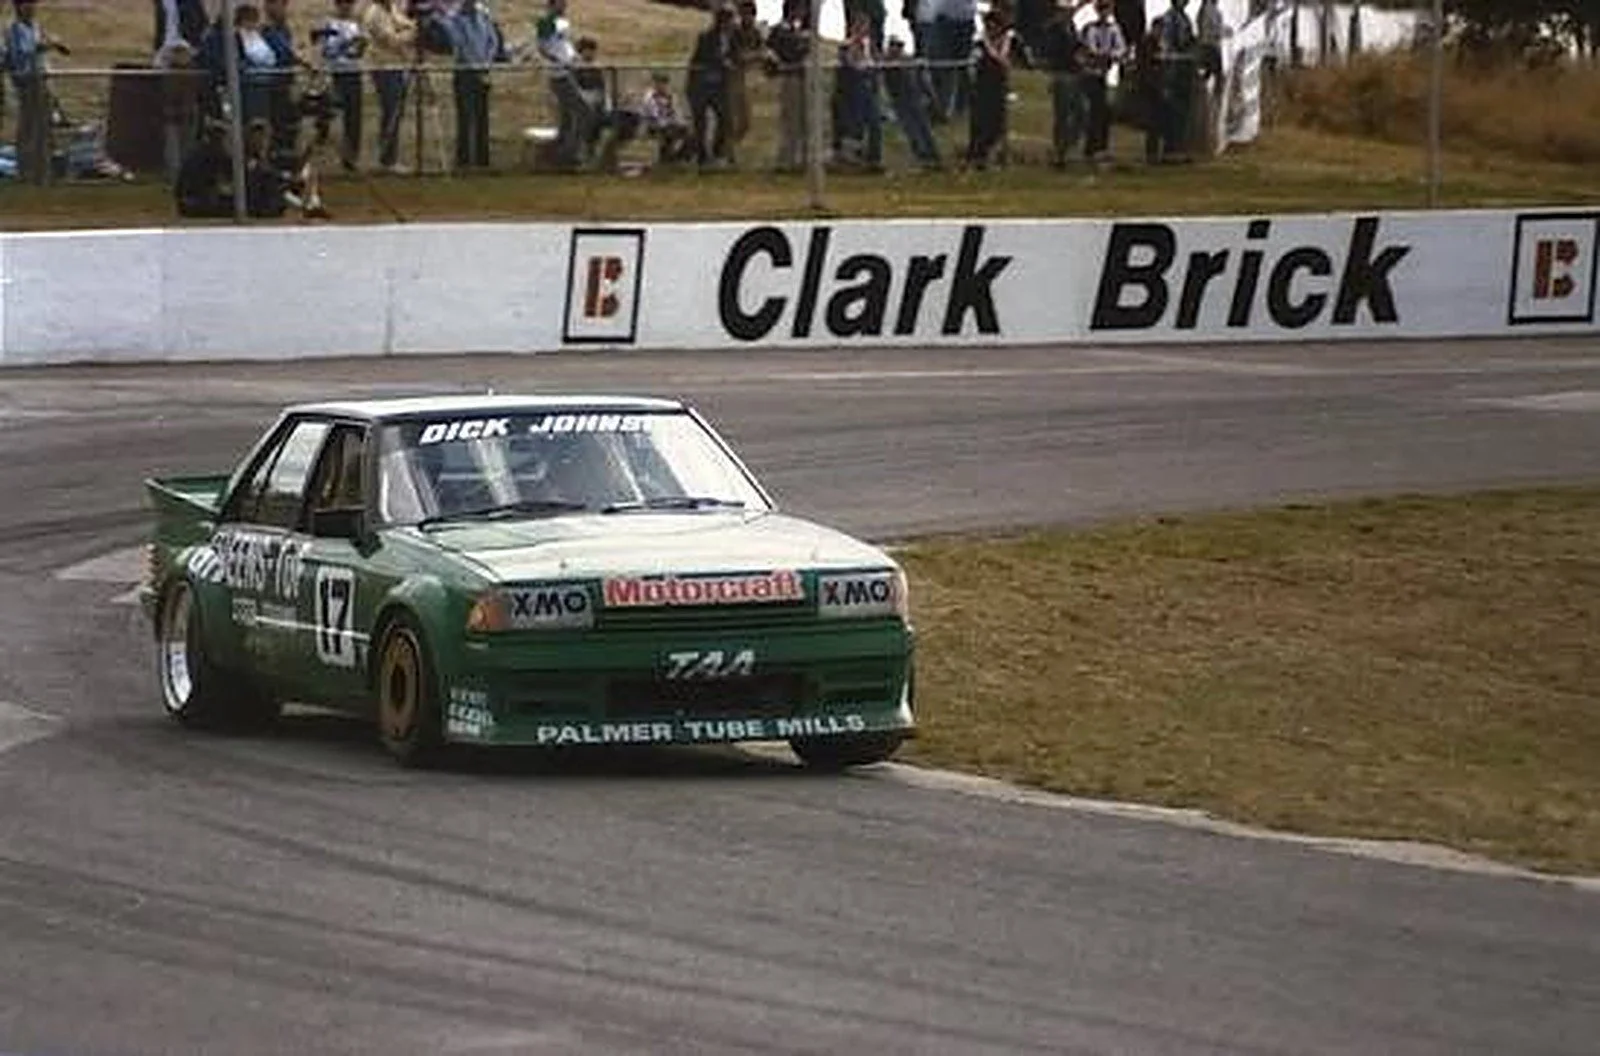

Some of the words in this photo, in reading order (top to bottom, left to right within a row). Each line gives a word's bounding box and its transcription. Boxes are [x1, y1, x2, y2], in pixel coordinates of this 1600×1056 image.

[718, 226, 1013, 341] Clark
[1090, 217, 1410, 330] Brick
[419, 417, 510, 445] DICK
[606, 570, 799, 605] Motorcraft
[823, 579, 891, 606] XMO
[319, 578, 350, 655] 17
[513, 591, 587, 617] XMO
[666, 650, 755, 679] TAA
[536, 723, 673, 744] PALMER
[684, 719, 765, 740] TUBE
[776, 714, 865, 736] MILLS
